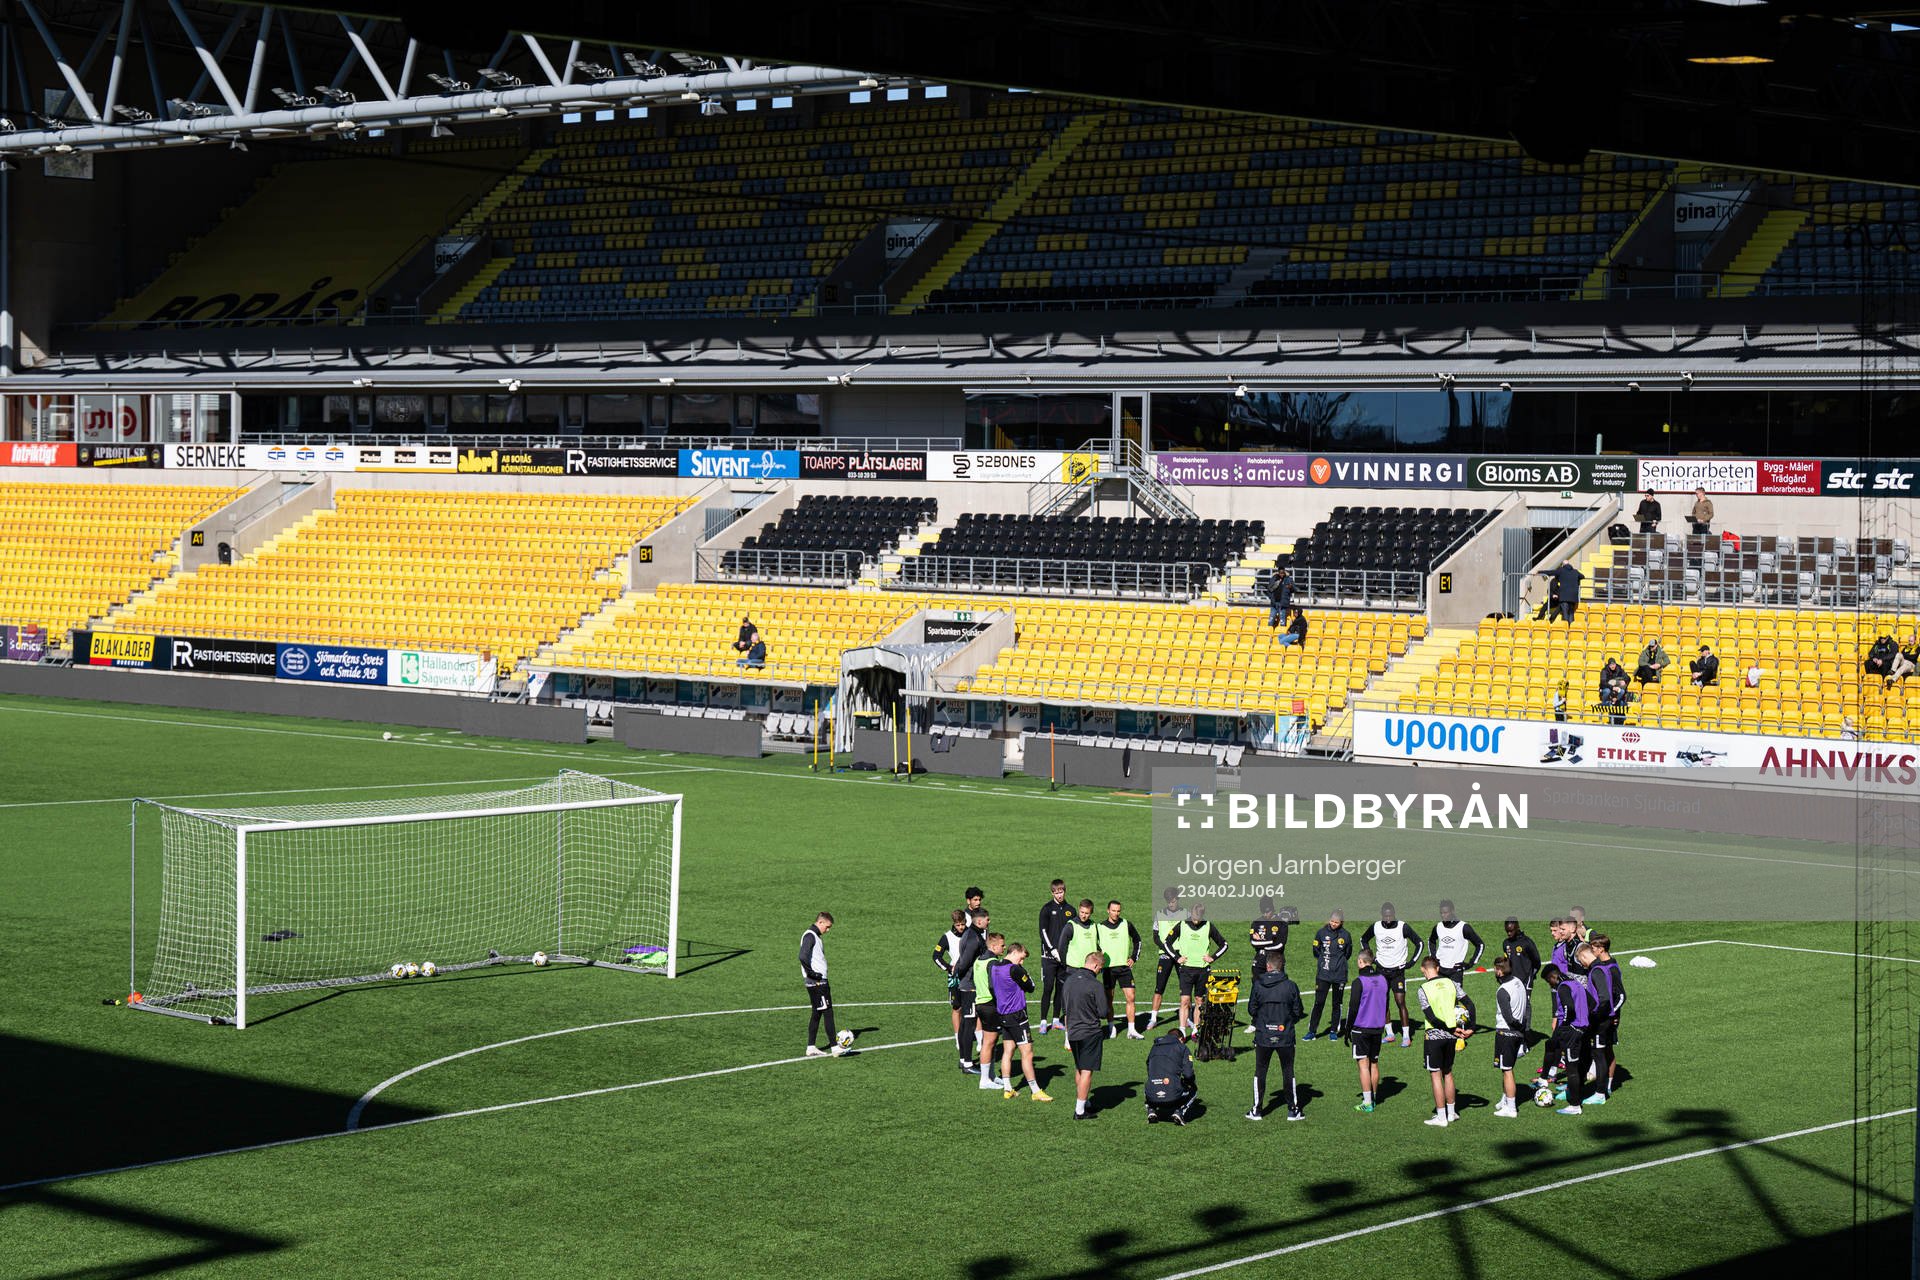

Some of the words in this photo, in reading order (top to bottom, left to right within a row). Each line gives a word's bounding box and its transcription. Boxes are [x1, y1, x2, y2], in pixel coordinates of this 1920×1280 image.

[94, 447, 146, 459] APROFIL.SE
[176, 446, 246, 467] SERNEKE
[501, 464, 564, 474] RÖRINSTALLATIONER
[588, 457, 676, 469] FASTIGHETSSERVICE
[691, 451, 749, 477] SILVENT
[804, 456, 845, 470] TOARPS
[849, 452, 923, 471] PLÅTSLAGERI
[976, 455, 1036, 468] 52BONES
[1763, 462, 1784, 473] Bygg
[1789, 462, 1814, 472] Måleri
[1173, 464, 1229, 480] amicus
[1247, 466, 1305, 482] amicus
[1335, 462, 1463, 482] VINNERGI
[1485, 465, 1541, 482] Bloms
[1544, 466, 1574, 483] AB
[1641, 461, 1754, 479] Seniorarbeten
[1771, 473, 1807, 485] Trädgård
[1827, 468, 1867, 489] stc
[1873, 468, 1914, 490] stc
[1762, 485, 1815, 494] seniorarbeten.se
[192, 533, 203, 544] A1
[641, 549, 652, 560] B1
[1441, 576, 1451, 590] E1
[927, 626, 961, 637] Sparbanken
[194, 650, 276, 666] FASTIGHETSSERVICE
[314, 651, 360, 667] Sjömarkens
[361, 653, 384, 665] Svets
[321, 666, 334, 677] och
[336, 667, 362, 679] Smide
[364, 668, 378, 679] AB
[1385, 718, 1506, 755] uponor
[1597, 747, 1667, 763] ETIKETT
[1758, 746, 1916, 785] AHNVIKS
